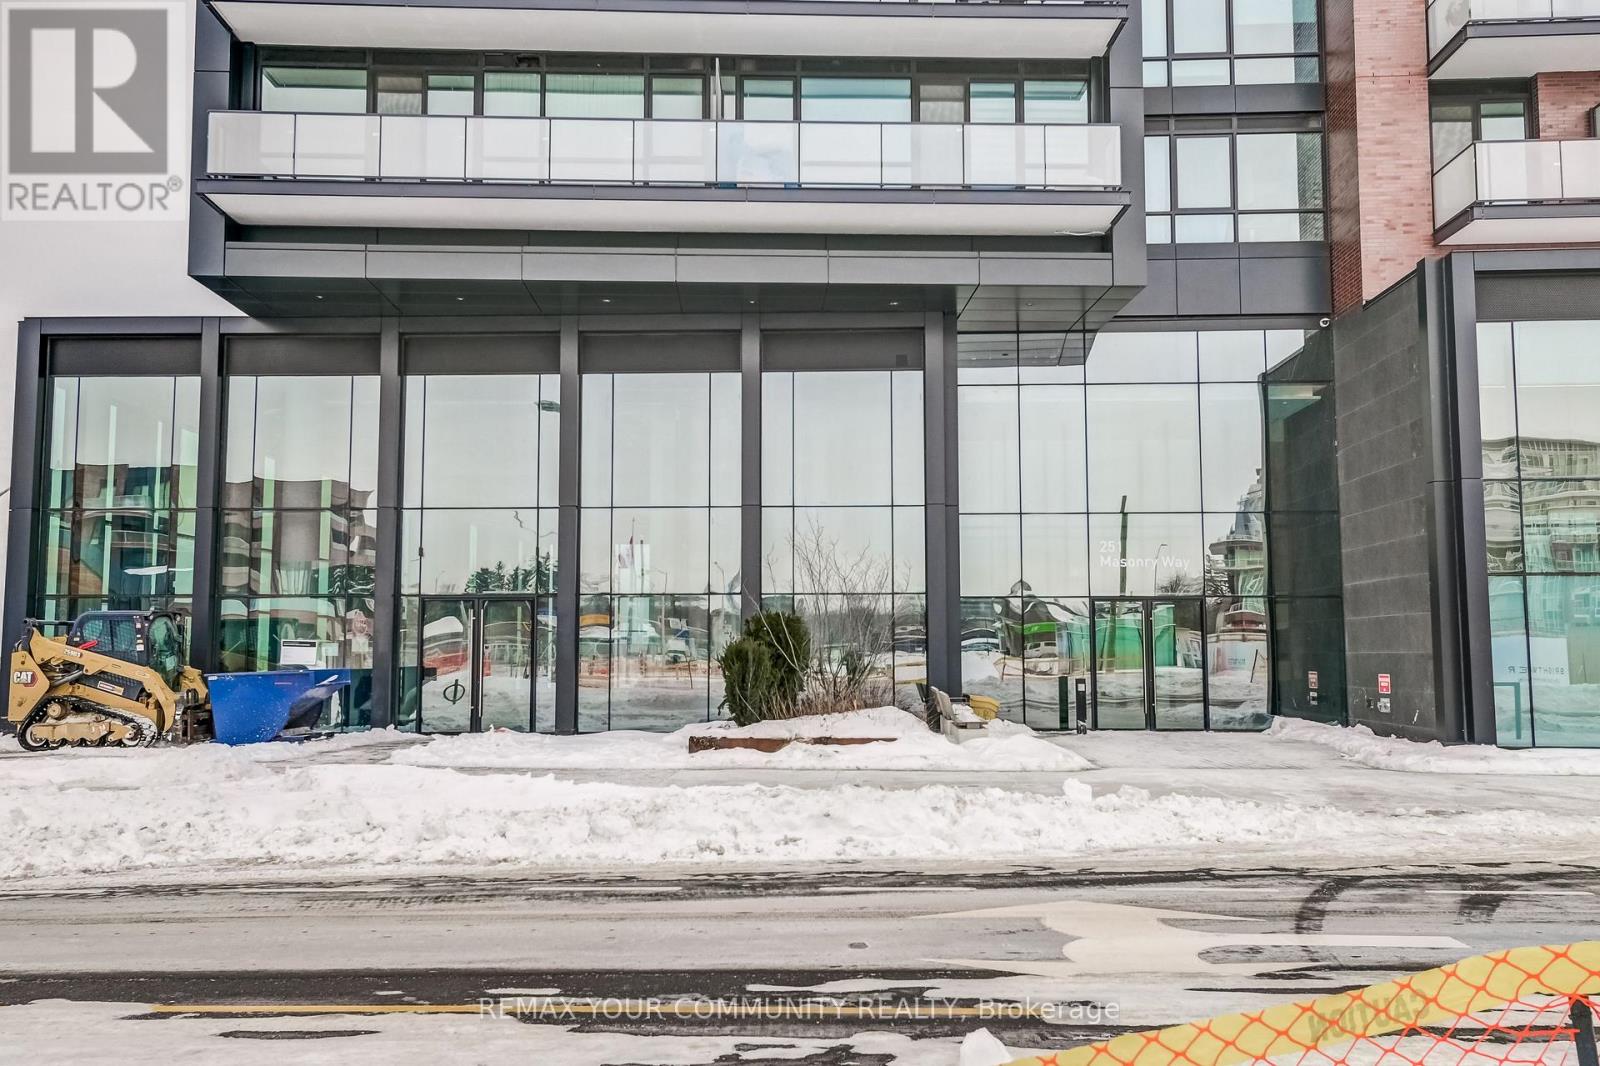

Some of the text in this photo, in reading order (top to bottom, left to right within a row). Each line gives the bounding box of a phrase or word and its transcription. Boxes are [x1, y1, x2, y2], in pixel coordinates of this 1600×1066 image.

[1100, 556, 1190, 569] Masonry Way
[13, 671, 33, 684] CAT
